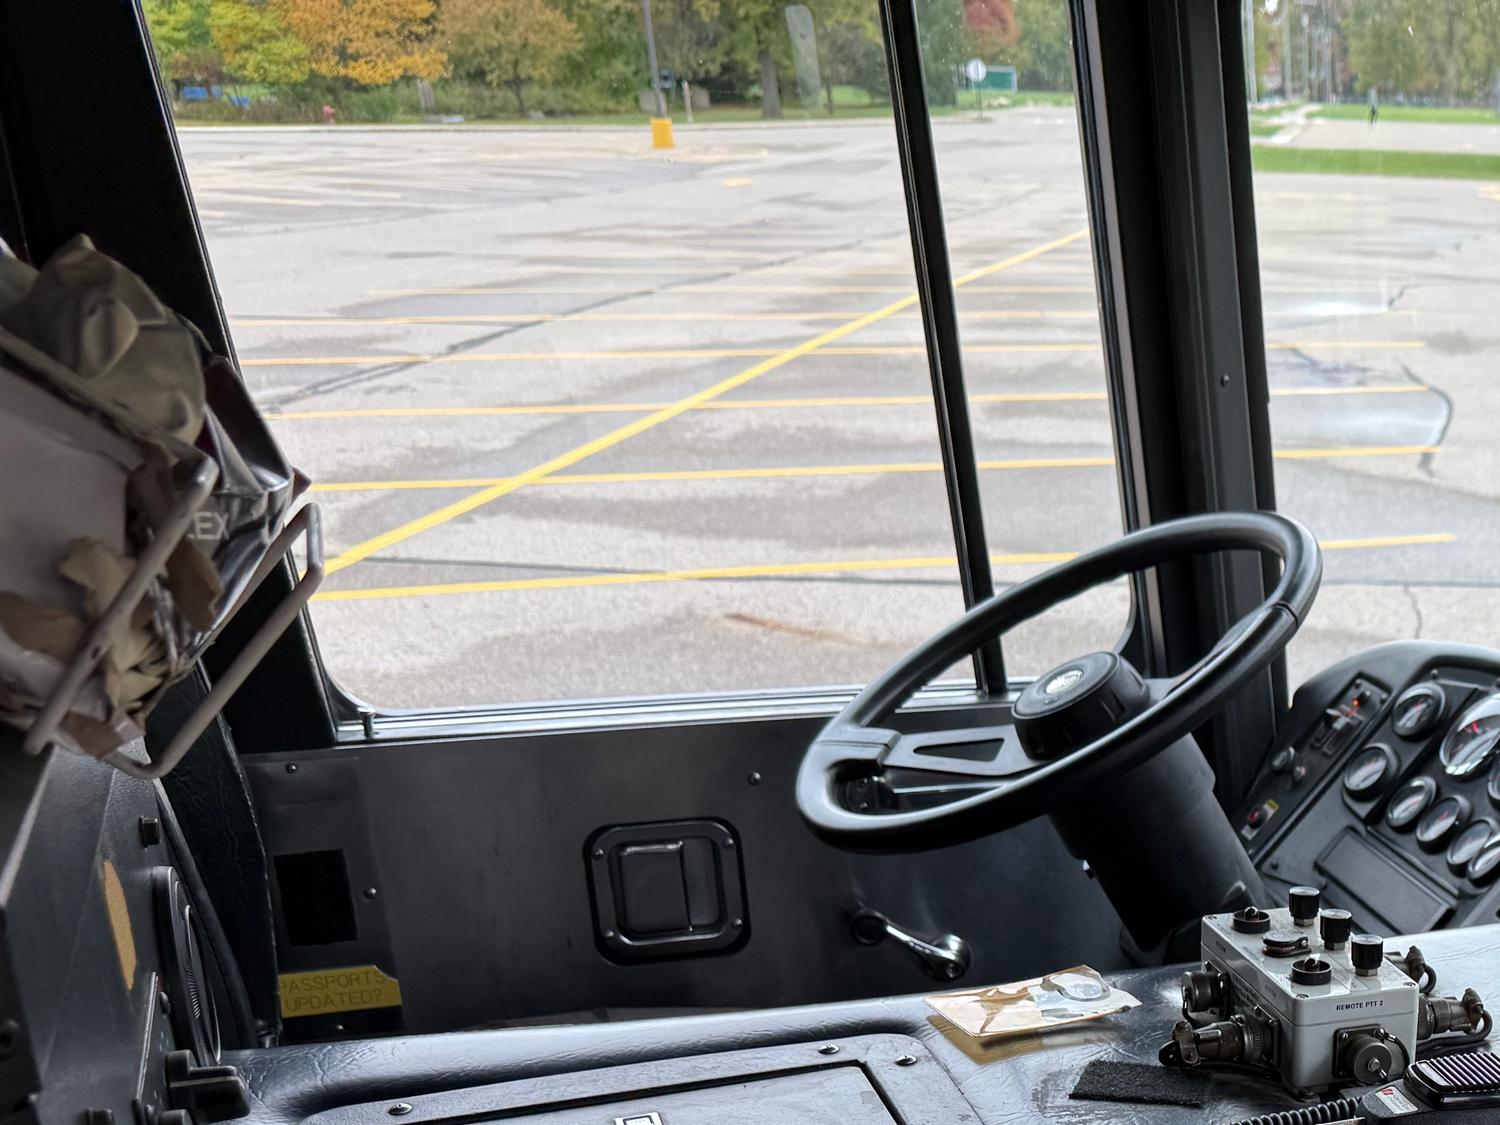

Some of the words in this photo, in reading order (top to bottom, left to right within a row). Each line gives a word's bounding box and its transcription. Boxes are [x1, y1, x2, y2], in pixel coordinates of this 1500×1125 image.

[187, 511, 229, 539] EX
[285, 989, 383, 1012] UPDATED?
[1336, 1002, 1364, 1012] REMOTE
[1365, 1000, 1378, 1009] PTT
